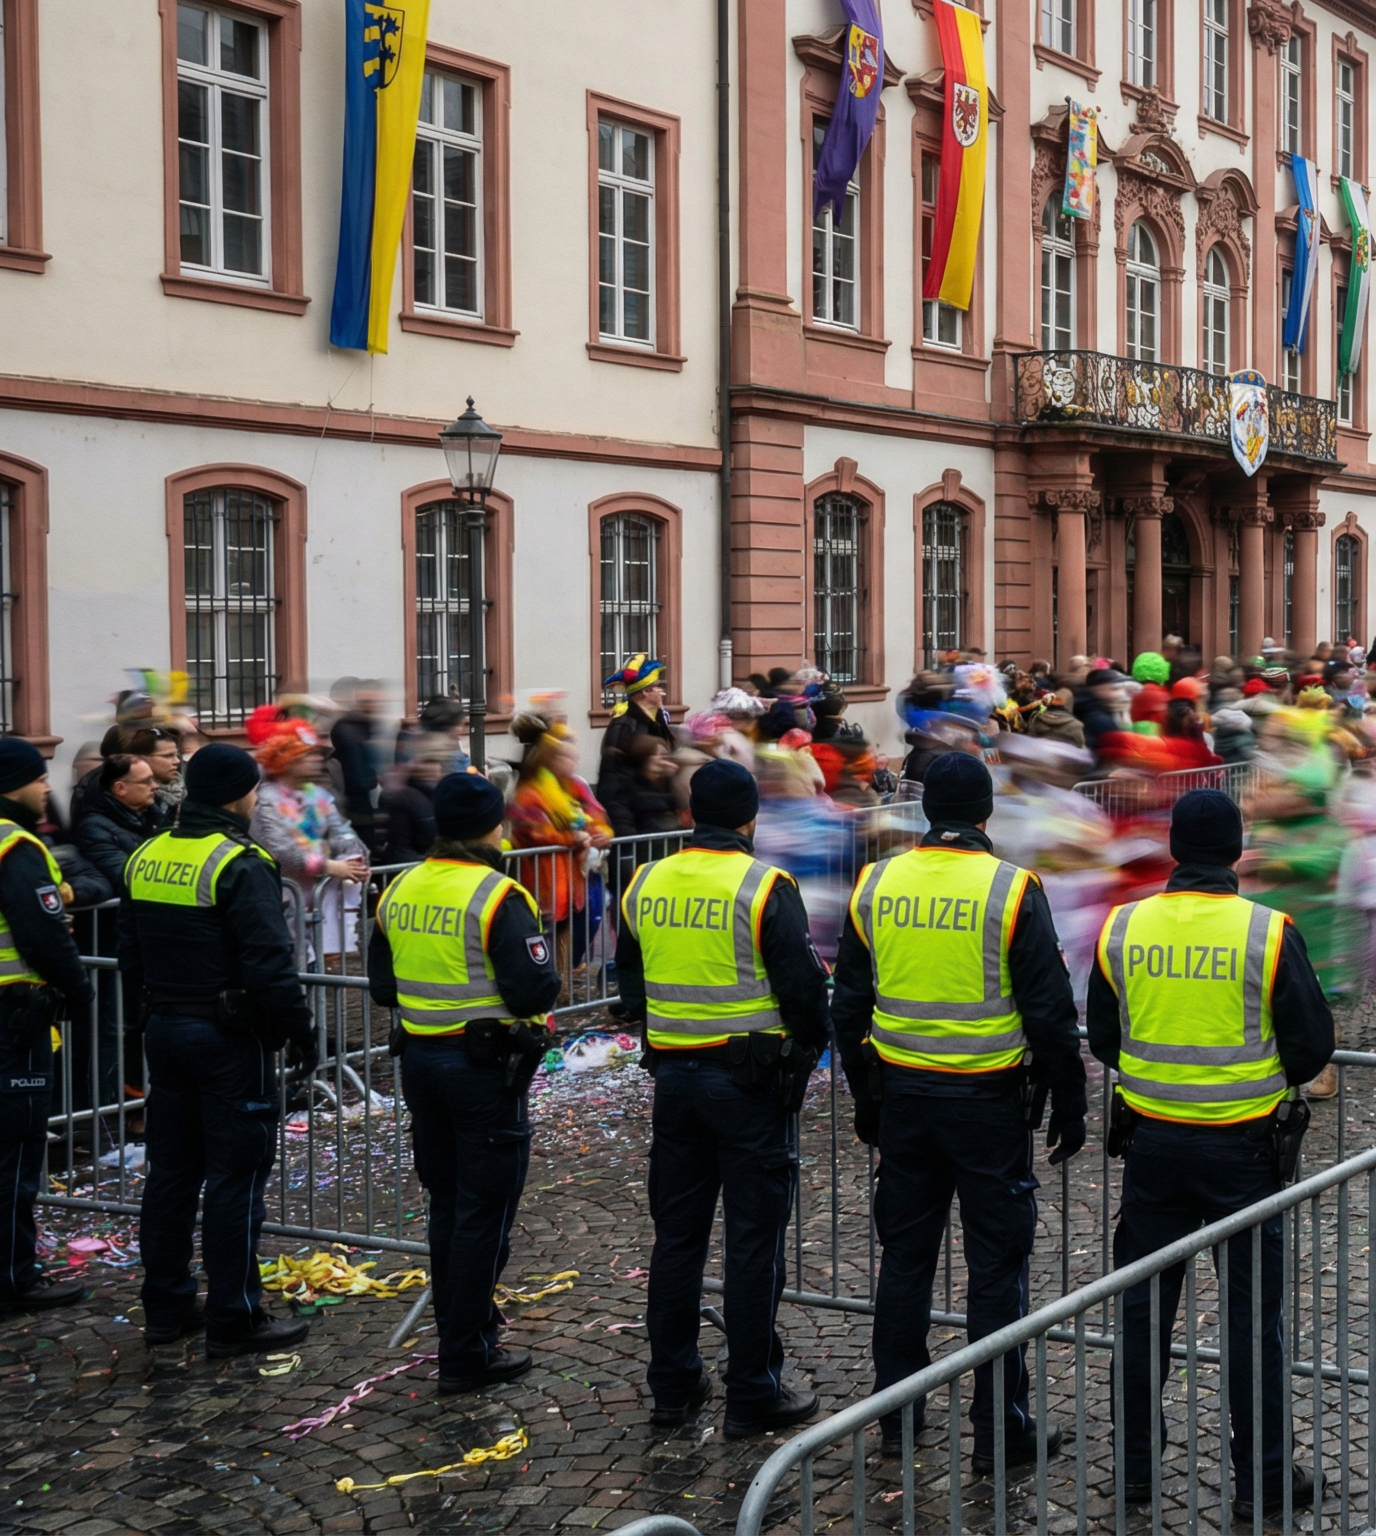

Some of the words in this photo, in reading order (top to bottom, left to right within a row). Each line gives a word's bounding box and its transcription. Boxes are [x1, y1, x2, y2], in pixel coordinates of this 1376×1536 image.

[134, 858, 198, 887] POLIZEI
[388, 901, 462, 938] POLIZEI
[640, 896, 729, 931] POLIZEI
[877, 895, 979, 932] POLIZEI
[1128, 944, 1237, 981] POLIZEI
